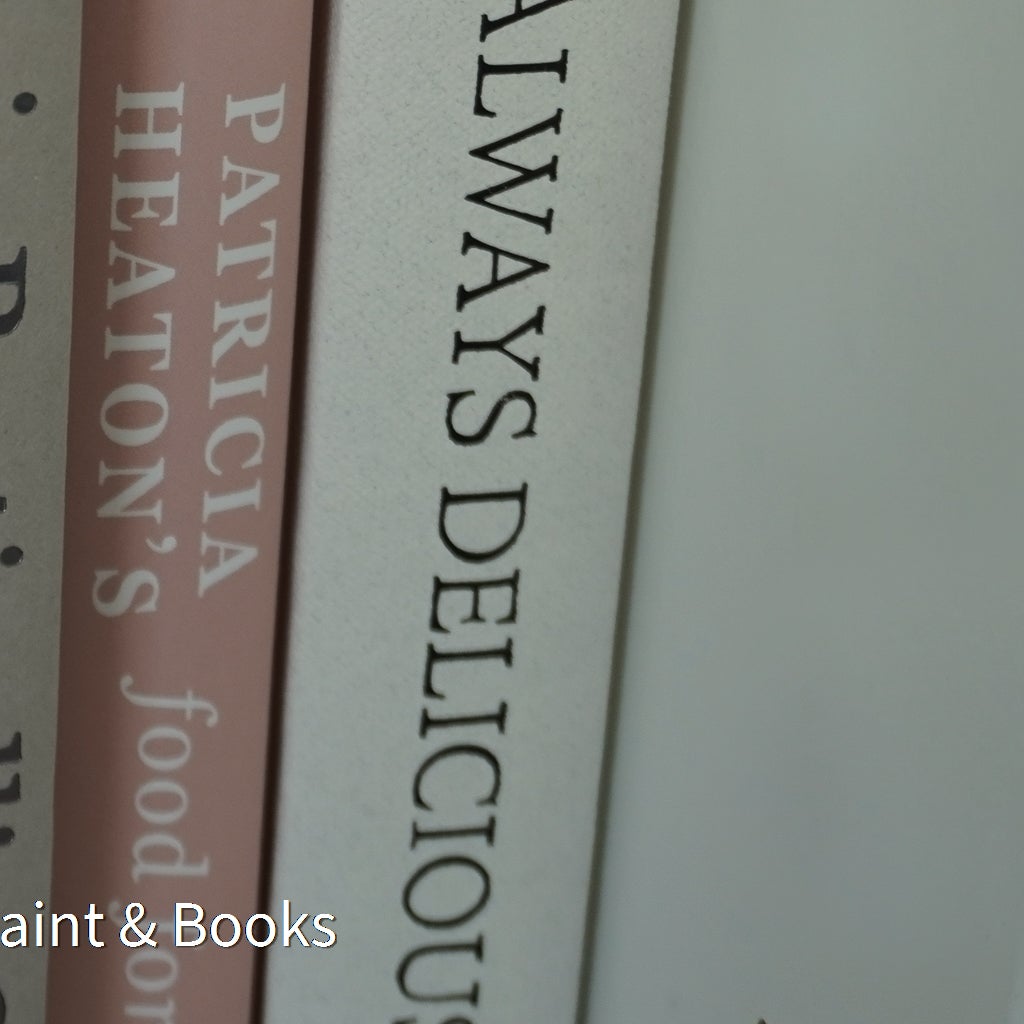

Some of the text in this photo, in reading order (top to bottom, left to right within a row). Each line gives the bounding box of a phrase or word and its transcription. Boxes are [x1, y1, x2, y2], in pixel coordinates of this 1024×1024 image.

[91, 81, 186, 619] HEATON'S
[197, 82, 287, 599] PATRICIA
[119, 675, 218, 884] food
[390, 481, 528, 1024] DELICIOU
